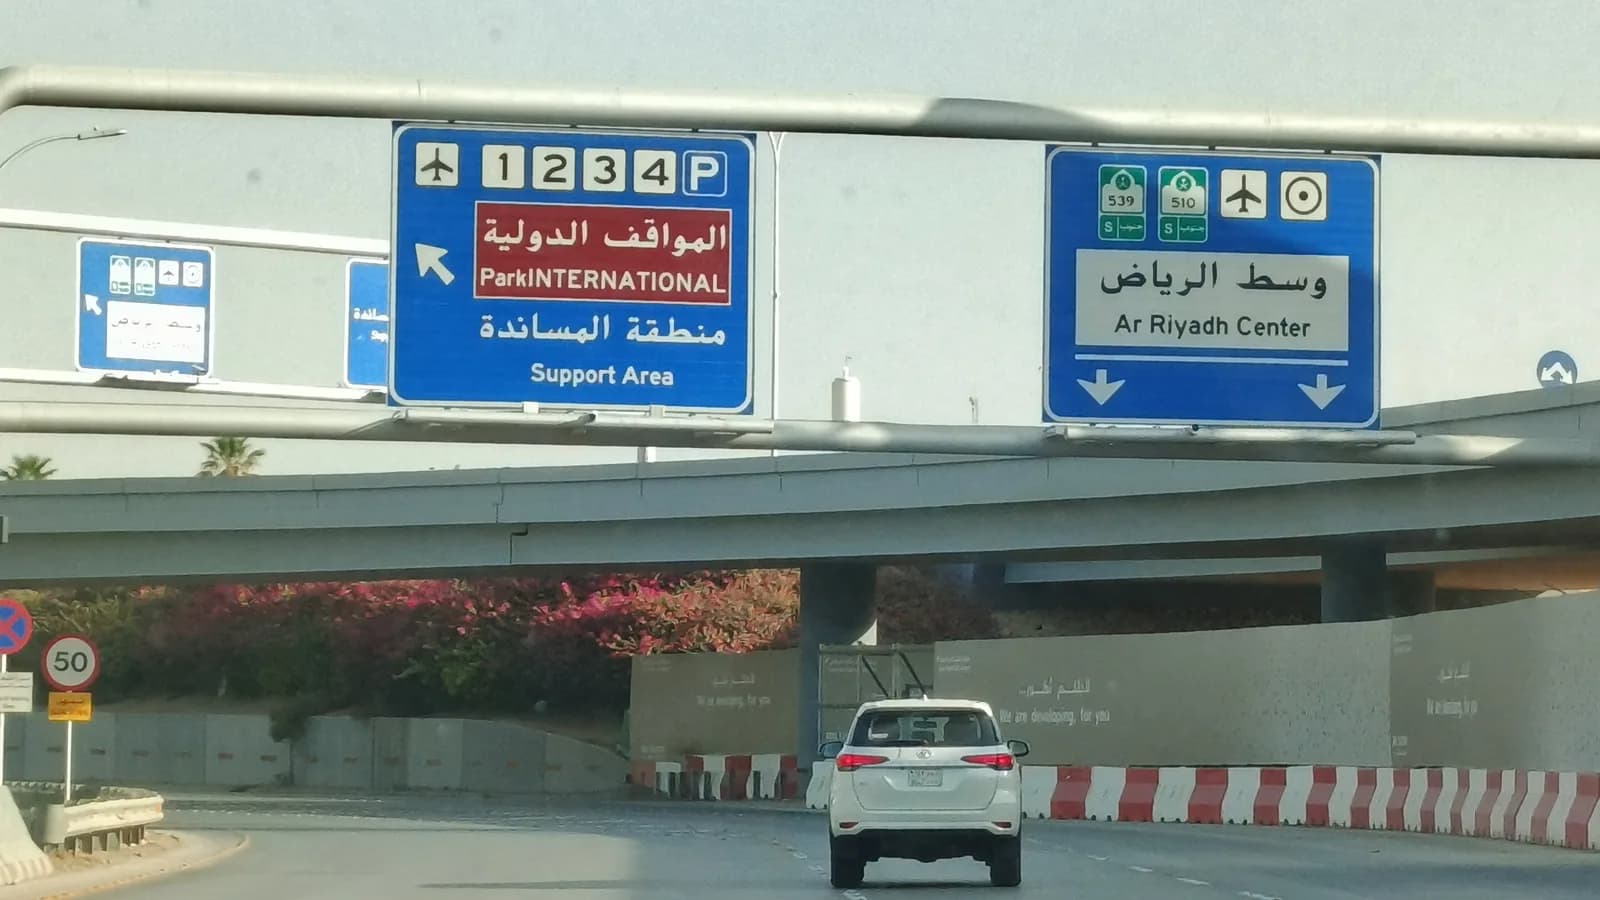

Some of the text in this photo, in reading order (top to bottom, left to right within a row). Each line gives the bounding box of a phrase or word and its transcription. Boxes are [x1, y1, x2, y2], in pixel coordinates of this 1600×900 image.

[498, 153, 720, 191] 1 2 3 4 P
[1108, 195, 1135, 207] 539
[1171, 197, 1196, 209] 510
[483, 217, 727, 257] المواقف الدولية
[1104, 221, 1113, 232] S
[1164, 223, 1173, 234] S
[480, 267, 727, 294] ParkINTERNATIONAL
[1101, 260, 1328, 300] وسط الرياض
[480, 312, 726, 346] منطقة المساندة
[1114, 314, 1311, 340] Ar Riyadh Center
[530, 363, 675, 388] Support Area
[53, 651, 88, 672] 50
